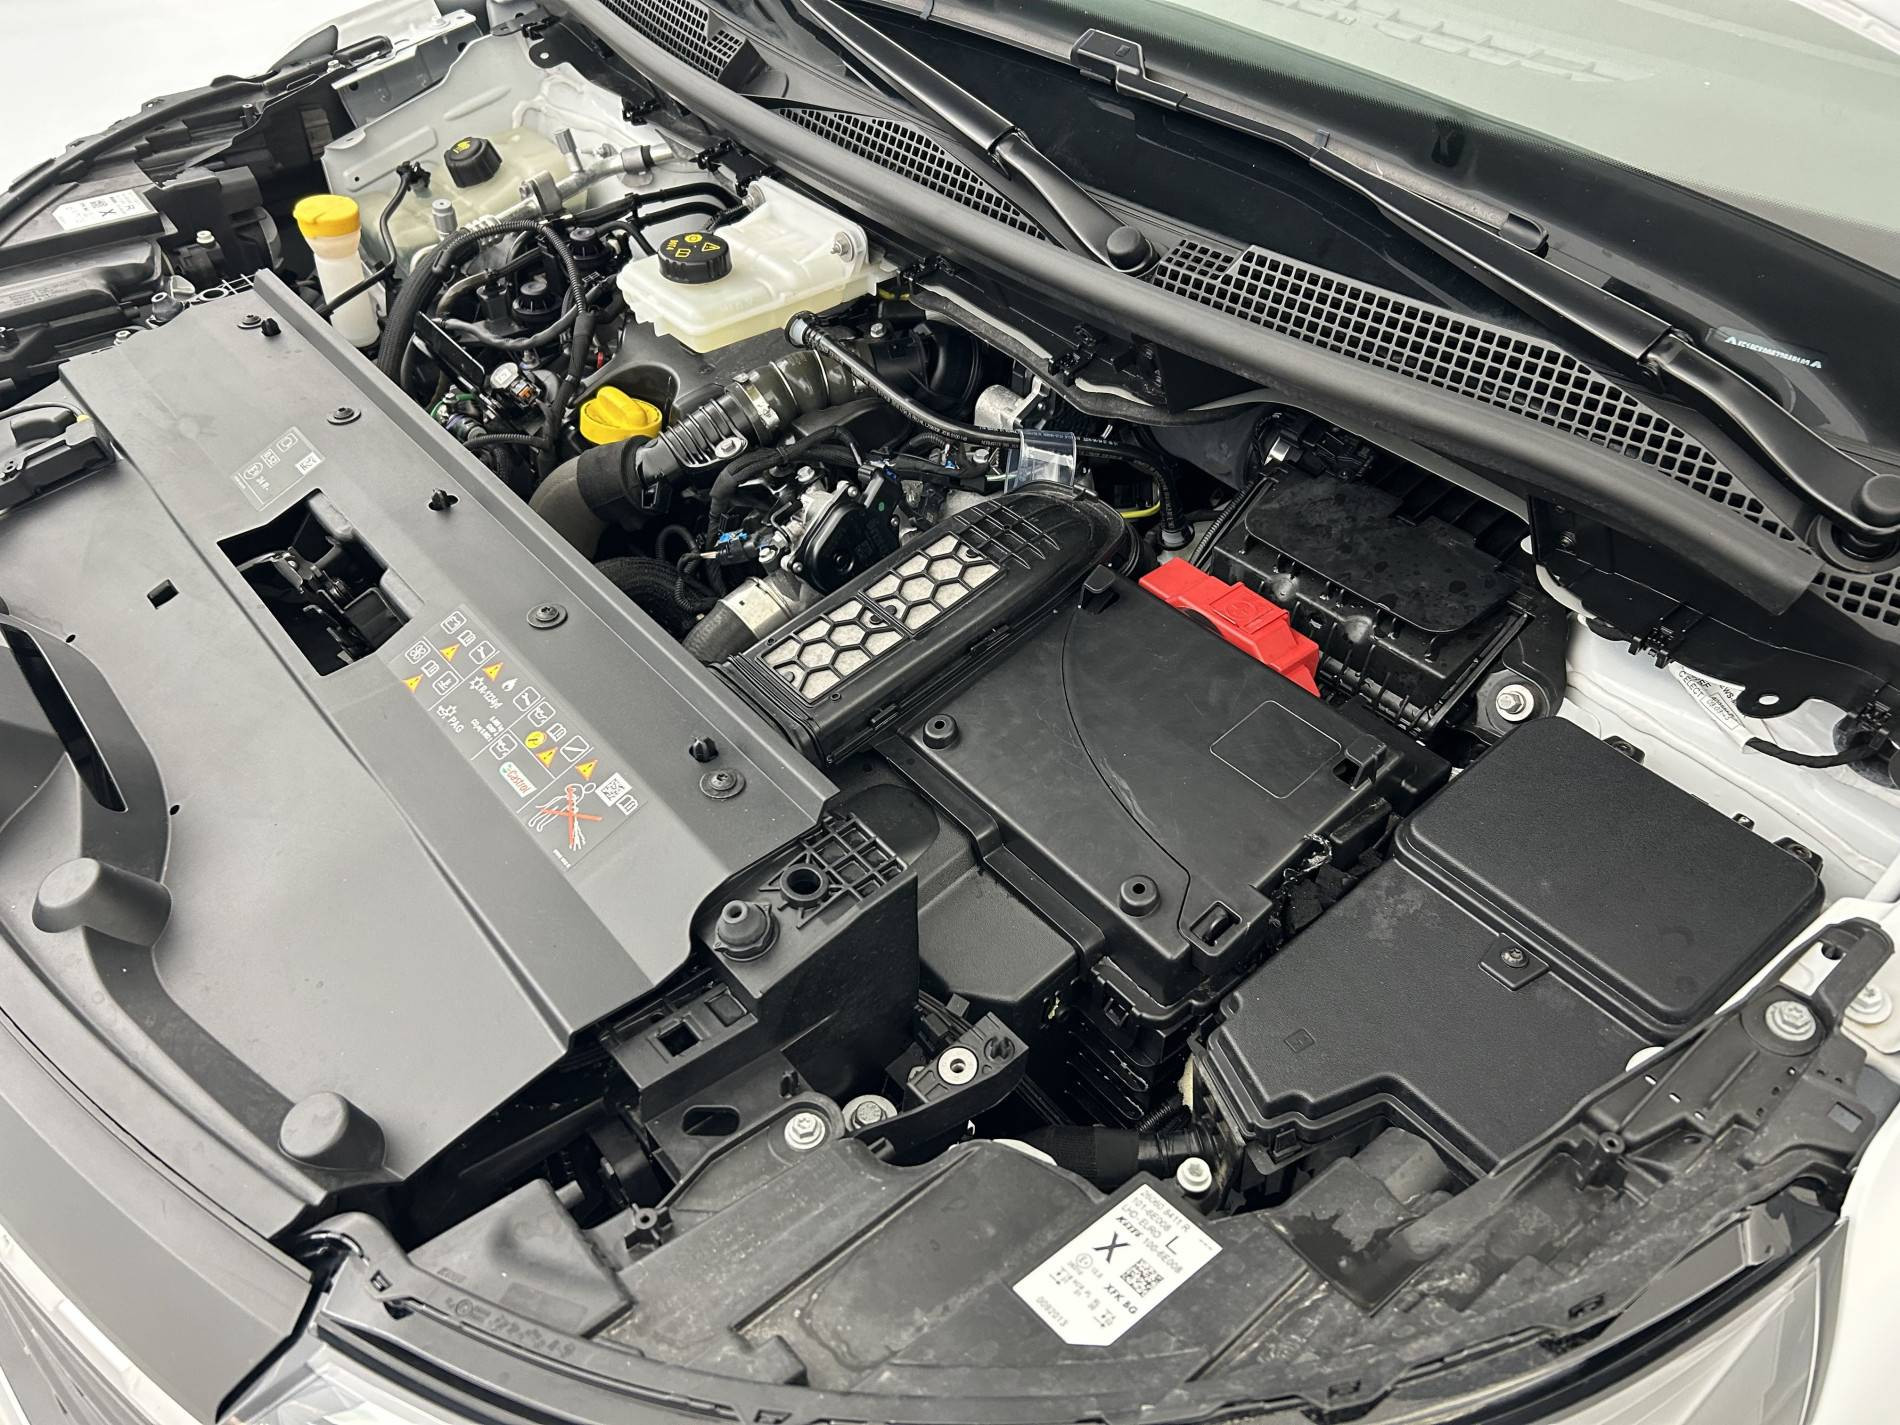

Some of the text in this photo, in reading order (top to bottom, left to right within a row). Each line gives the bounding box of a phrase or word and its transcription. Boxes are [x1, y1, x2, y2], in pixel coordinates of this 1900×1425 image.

[448, 716, 464, 733] PAG
[506, 767, 530, 794] Castrol
[1094, 1231, 1131, 1264] X
[1165, 1235, 1179, 1255] L
